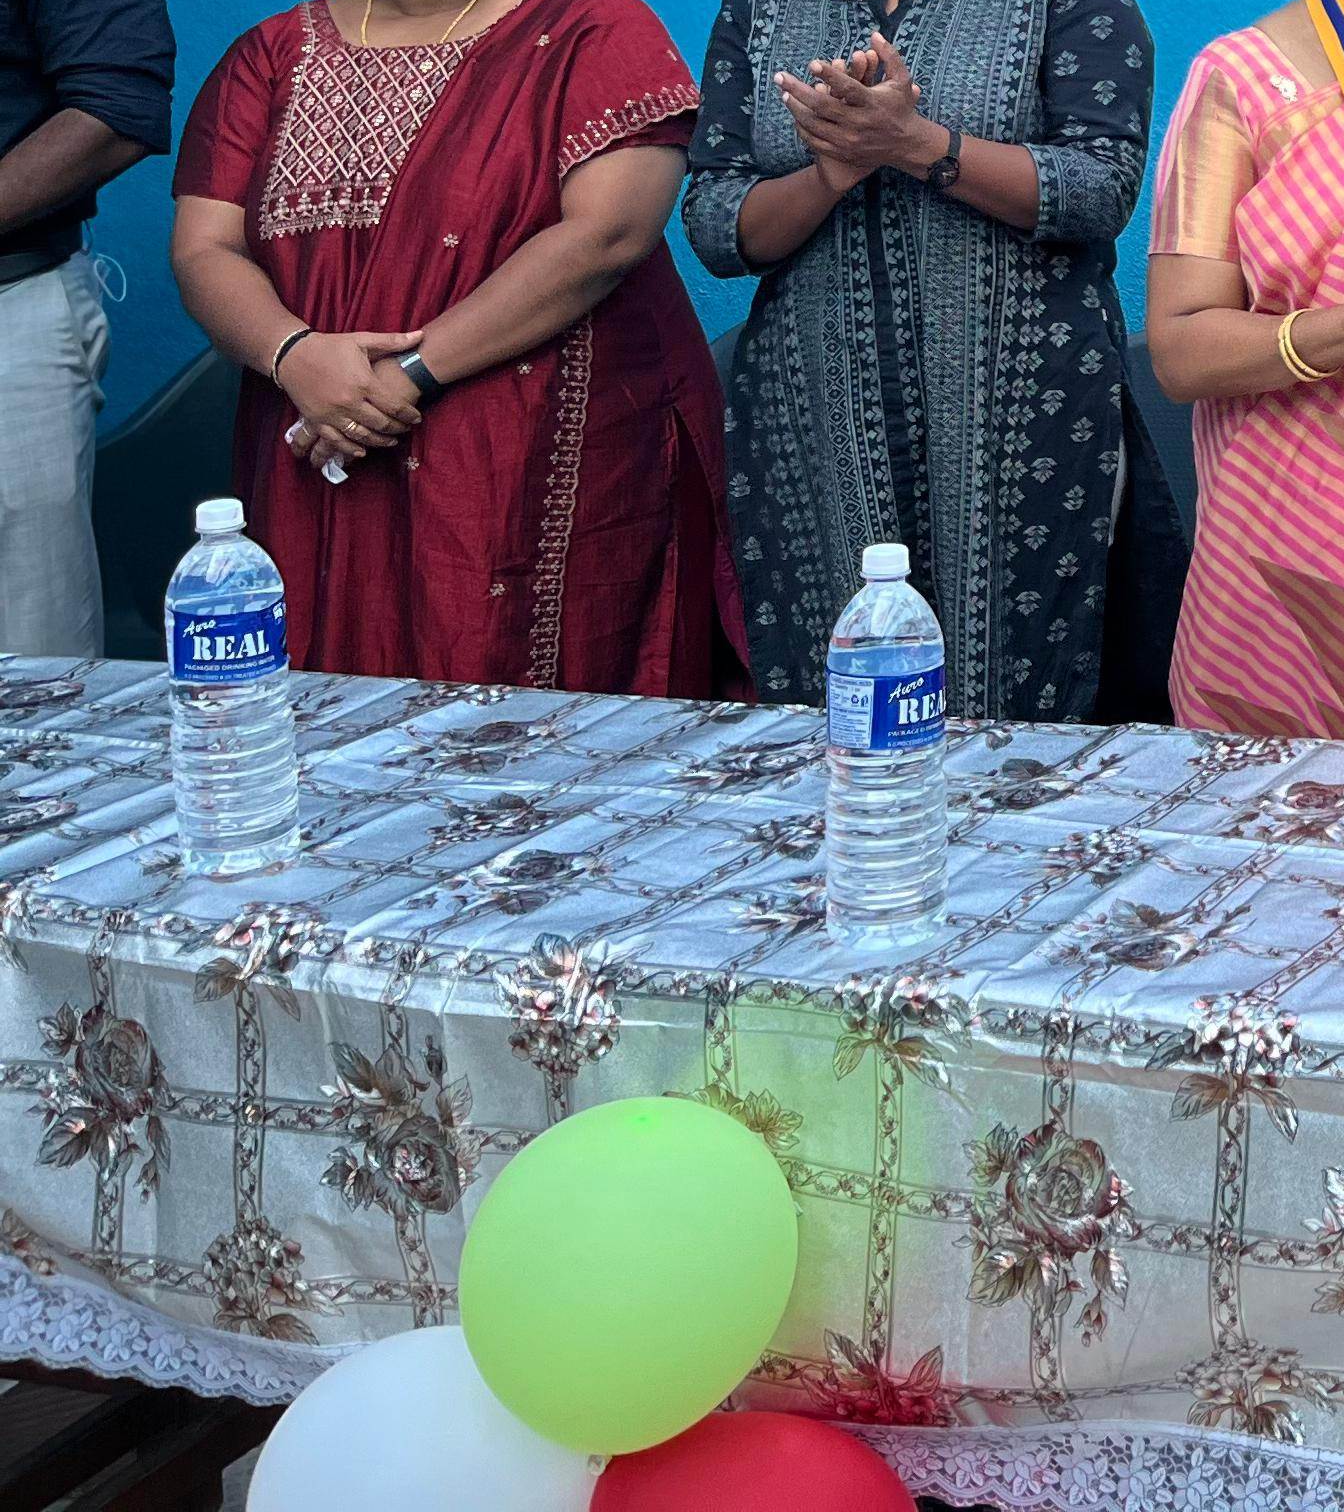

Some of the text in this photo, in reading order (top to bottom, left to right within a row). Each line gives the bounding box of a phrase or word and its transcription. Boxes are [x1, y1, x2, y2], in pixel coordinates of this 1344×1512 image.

[193, 629, 270, 661] REAL
[888, 677, 924, 704] Auro
[898, 687, 946, 725] REA
